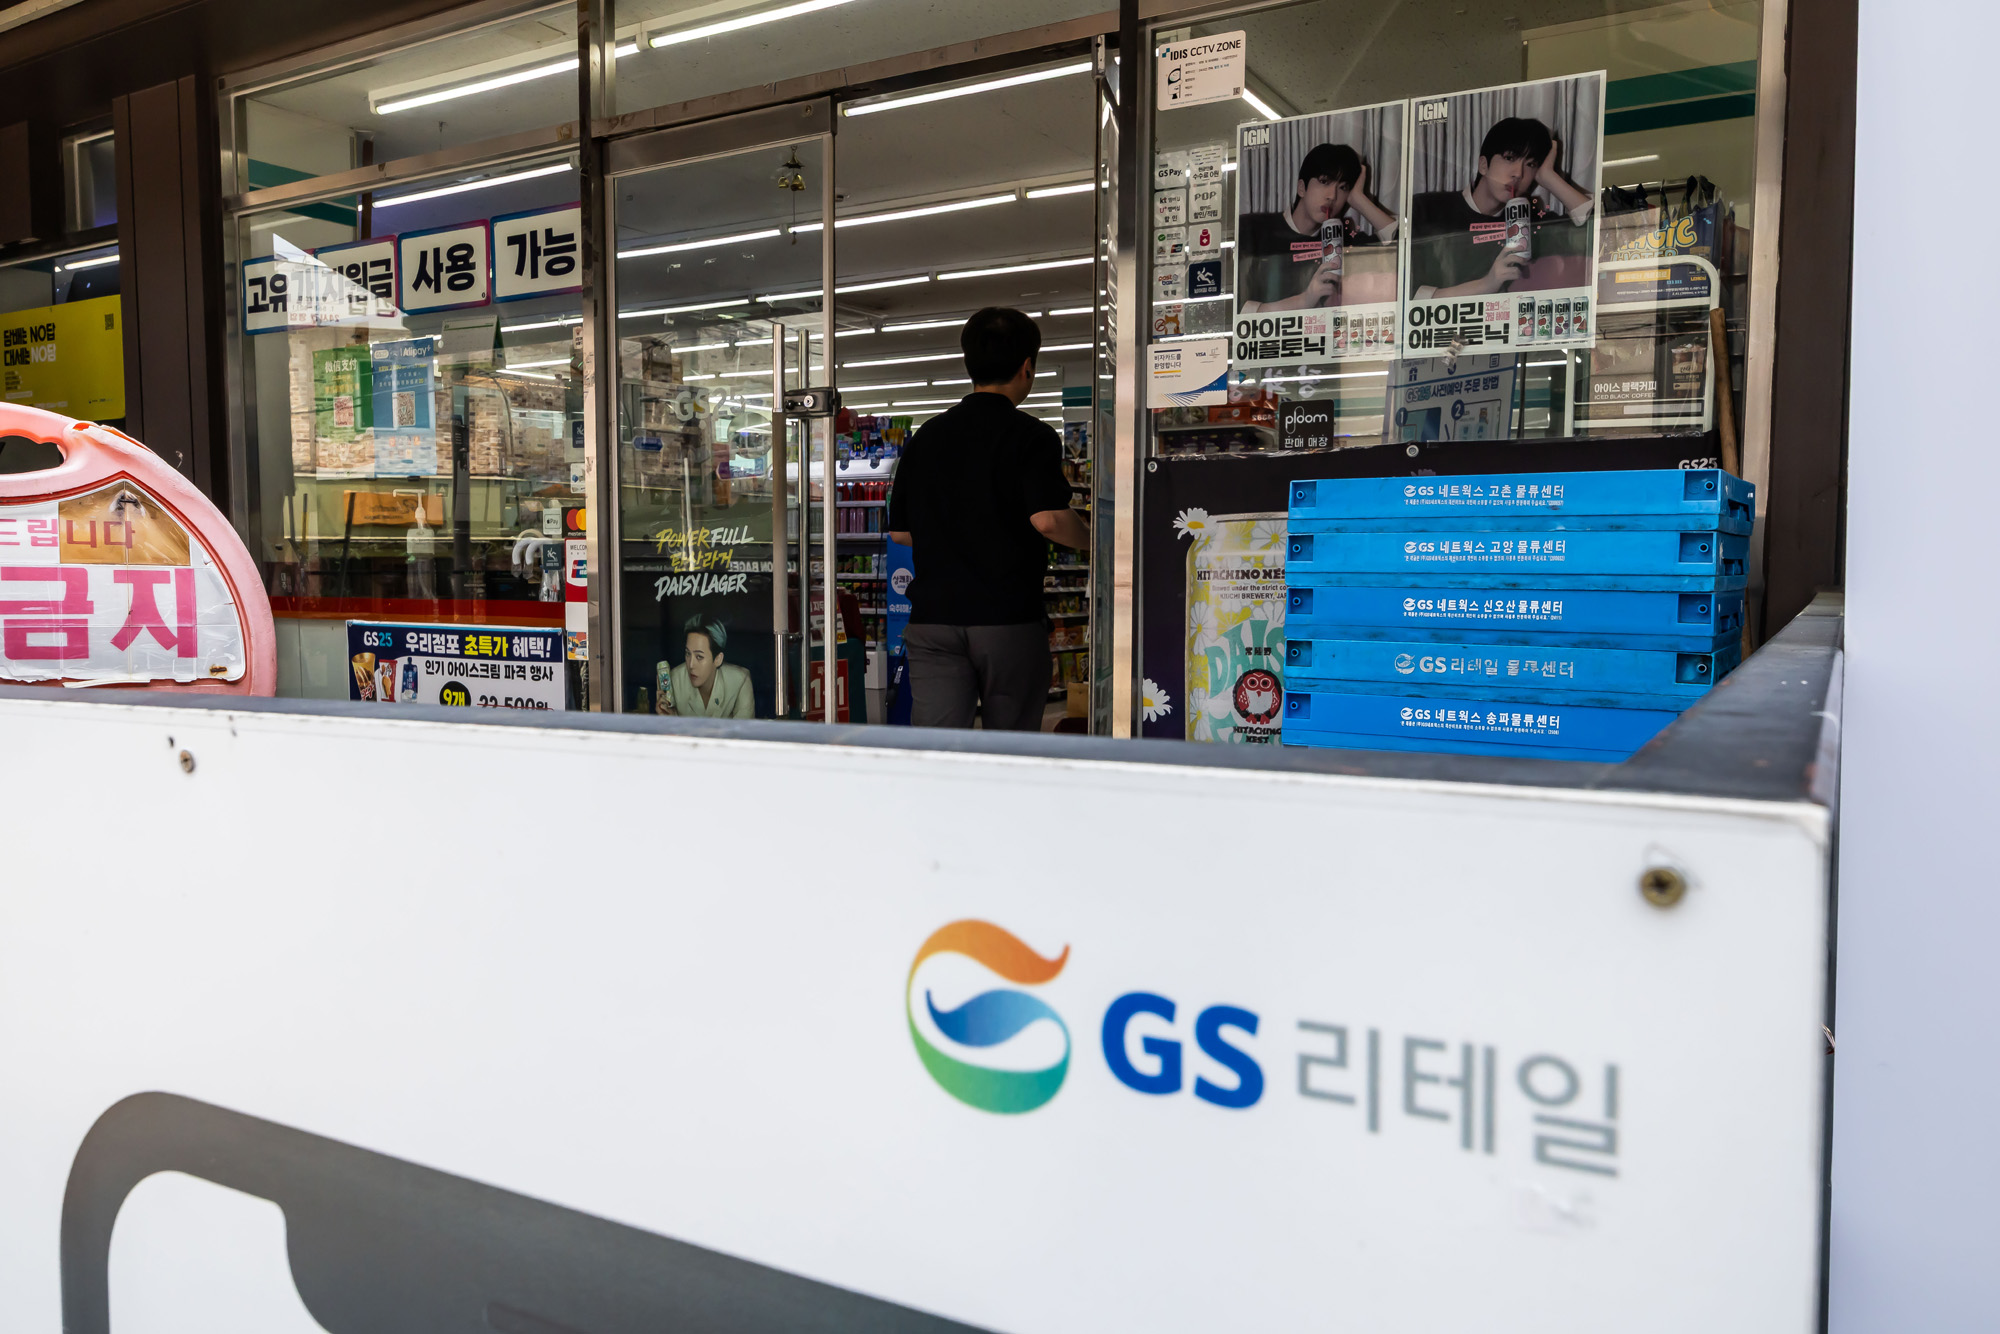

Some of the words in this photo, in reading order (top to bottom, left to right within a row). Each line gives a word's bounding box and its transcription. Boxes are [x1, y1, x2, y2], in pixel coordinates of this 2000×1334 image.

[1170, 48, 1188, 61] IDIS
[1190, 43, 1215, 57] CCTV
[1216, 39, 1241, 52] ZONE
[1418, 101, 1448, 122] IGIN
[1243, 127, 1270, 147] IGIN
[1158, 170, 1168, 178] GS
[1192, 171, 1209, 180] 수수료
[1209, 170, 1219, 178] 0원
[1194, 191, 1217, 201] POP
[1505, 202, 1529, 223] IGIN
[1321, 224, 1343, 240] IGIN
[321, 257, 394, 303] 지원금
[412, 242, 476, 294] 사용
[506, 227, 577, 280] 가능
[1518, 302, 1535, 313] IGIN
[1537, 305, 1553, 315] IGIN
[1555, 303, 1570, 313] IGIN
[1573, 301, 1589, 312] IGIN
[1333, 316, 1348, 327] IGIN
[1350, 318, 1363, 328] IGIN
[1365, 317, 1378, 327] IGIN
[1381, 316, 1395, 326] IGIN
[1408, 323, 1510, 349] 애플토닉
[1236, 336, 1326, 361] 애플토닉
[1154, 353, 1181, 362] 비자카드를
[325, 357, 357, 373] 微信支付
[1154, 361, 1181, 370] 환영합니다
[1406, 385, 1431, 403] GS25
[1431, 381, 1463, 398] 사전예약
[1464, 377, 1480, 393] 주문
[1482, 375, 1500, 391] 방법
[1594, 381, 1621, 394] 아이스
[1621, 380, 1657, 393] 블랙커피
[1455, 403, 1461, 417] 2
[1285, 406, 1328, 434] ploom
[1284, 436, 1304, 449] 판매
[1309, 435, 1328, 448] 매장
[1678, 457, 1718, 470] GS25
[1418, 486, 1434, 496] GS
[1438, 484, 1484, 498] 네트웍스
[1489, 484, 1512, 499] 고촌
[1516, 484, 1565, 499] 물류센터
[656, 525, 754, 554] POWERFULL
[1418, 542, 1435, 552] GS
[1439, 540, 1485, 554] 네트웍스
[1490, 540, 1514, 554] 고양
[1517, 540, 1566, 554] 물류센터
[1197, 569, 1261, 581] HITACHINO
[654, 575, 701, 602] DAISY
[700, 572, 748, 597] LAGER
[1241, 592, 1275, 600] BREWERY,
[1417, 599, 1433, 610] GS
[1437, 599, 1479, 612] 네트웍스
[0, 566, 198, 661] 금지
[363, 631, 392, 647] GS25
[405, 631, 460, 655] 우리점포
[464, 634, 508, 657] 초특가
[512, 636, 552, 658] 혜택!
[424, 659, 445, 676] 인기
[448, 661, 500, 680] 아이스크림
[504, 664, 526, 680] 파격
[530, 665, 553, 682] 행사
[1419, 656, 1447, 674] GS
[1451, 657, 1498, 676] 리테일
[443, 688, 465, 707] 9개
[810, 676, 844, 709] 11
[1414, 709, 1431, 720] GS
[1435, 709, 1481, 723] 네트웍스
[1245, 735, 1269, 745] NEST
[1101, 991, 1265, 1110] GS
[1296, 1018, 1620, 1179] 리테일
